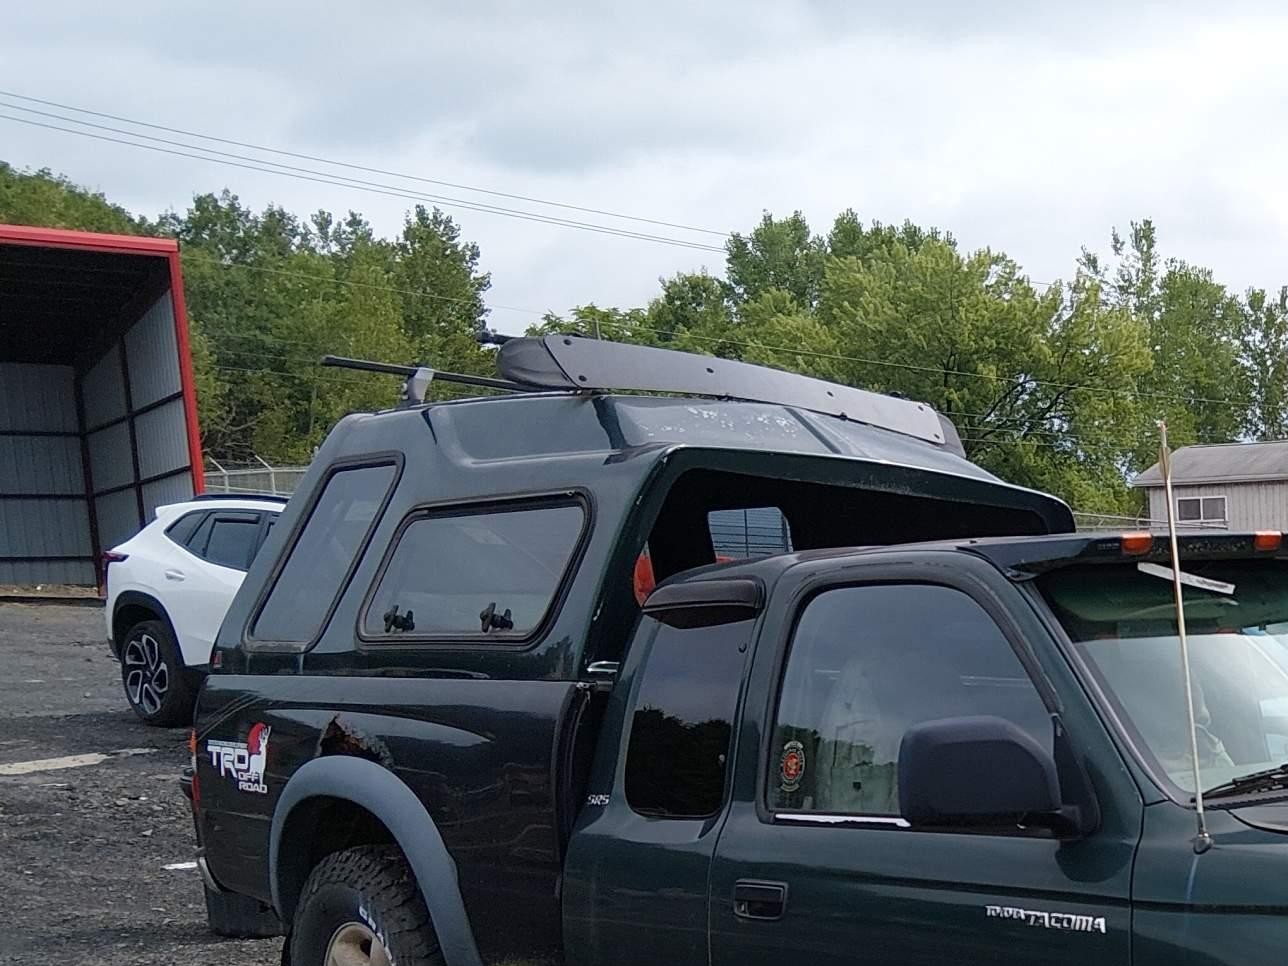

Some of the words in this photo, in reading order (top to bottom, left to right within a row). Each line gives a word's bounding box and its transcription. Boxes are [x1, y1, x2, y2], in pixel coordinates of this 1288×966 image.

[207, 745, 249, 778] TRD
[238, 771, 259, 782] OFF
[238, 781, 268, 794] ROAD
[1023, 911, 1107, 934] TACOMA
